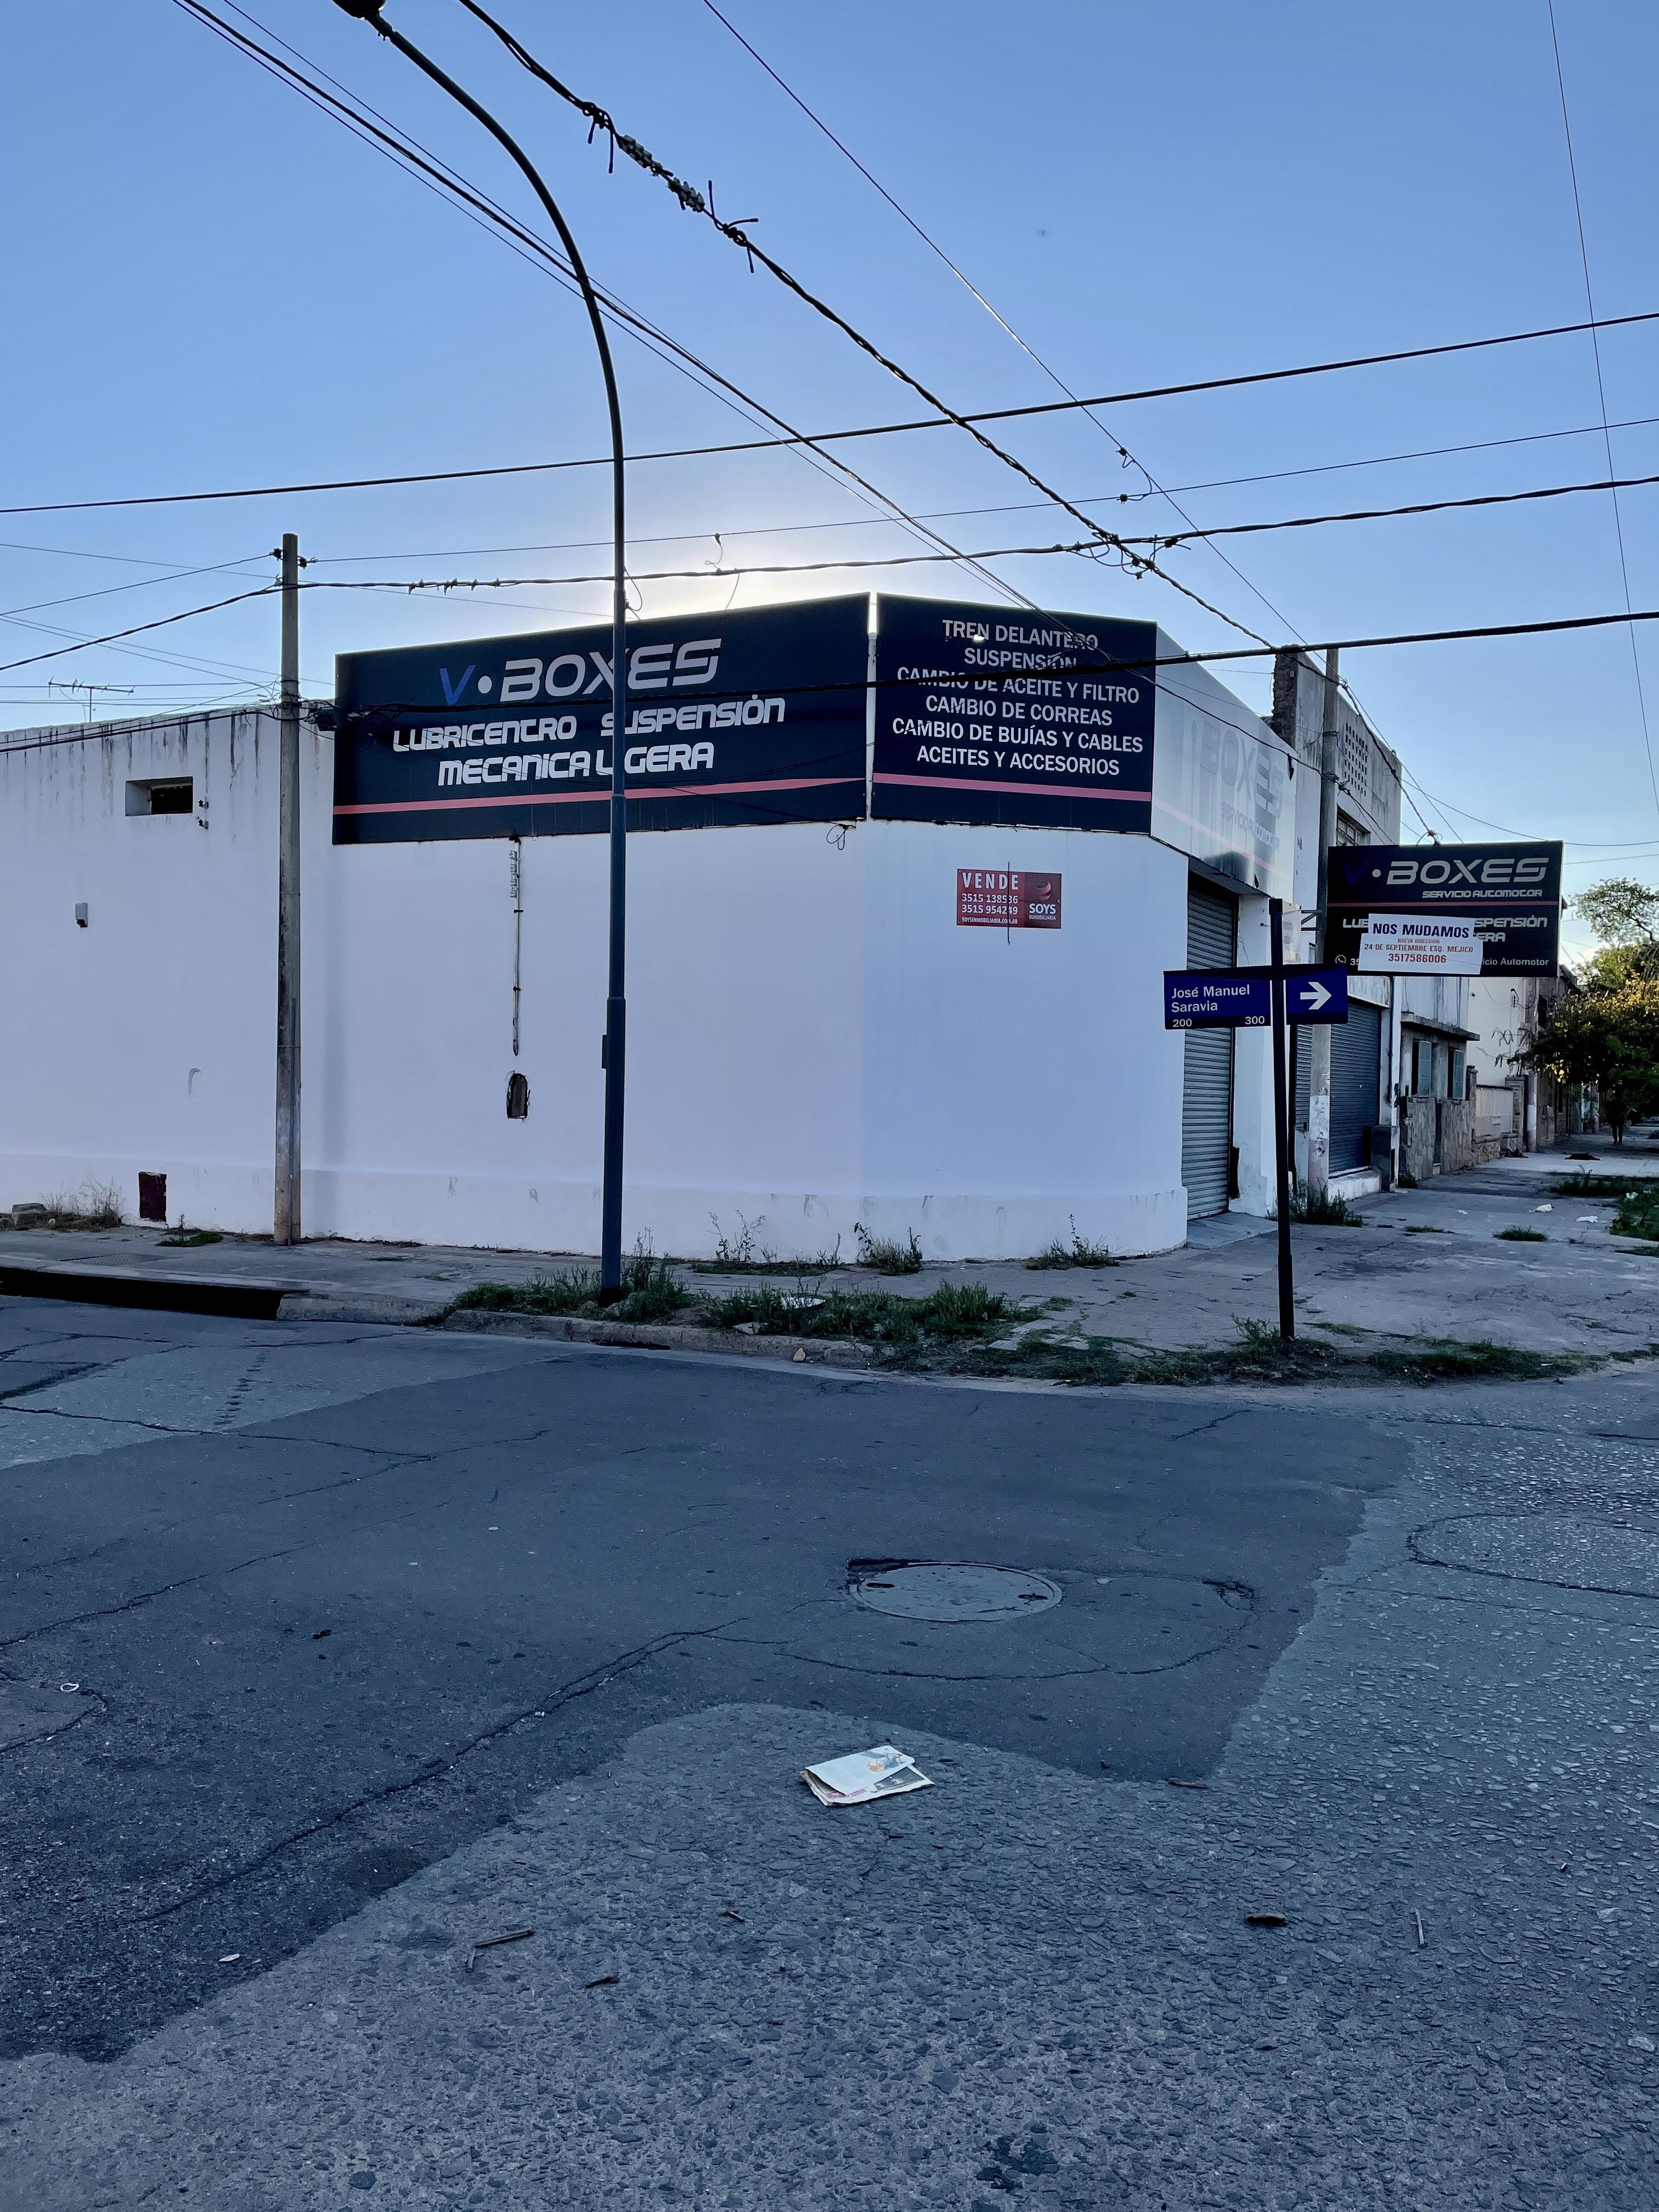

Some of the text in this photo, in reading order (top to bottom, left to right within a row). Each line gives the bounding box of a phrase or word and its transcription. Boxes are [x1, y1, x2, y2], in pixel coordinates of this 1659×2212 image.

[943, 619, 989, 640] TREN
[1002, 678, 1063, 698] ACEITE
[1066, 681, 1078, 698] Y
[1083, 684, 1139, 703] FILTRO
[926, 695, 1113, 726] CAMBIO DE CORREAS
[393, 715, 577, 752] LUBRICENTRO
[893, 718, 1143, 753] CAMBIO DE BUJÍAS Y CABLES
[438, 742, 714, 786] MECANICA LGERA
[917, 746, 1120, 776] ACEITES Y ACCESORIOS
[962, 872, 1018, 890] VENDE
[962, 893, 983, 902] 3515
[1422, 889, 1543, 899] SERVICIO AUTOMOTOR
[962, 904, 983, 913] 3515
[1029, 904, 1056, 914] SOYS
[1474, 915, 1548, 928] SPENSIÓN
[1373, 923, 1469, 938] NOS MUDAMOS
[1388, 953, 1446, 963] 3517586006
[1172, 984, 1250, 998] José Manuel
[1172, 1000, 1217, 1012] Saravia
[1173, 1019, 1192, 1027] 200
[1245, 1016, 1265, 1024] 300
